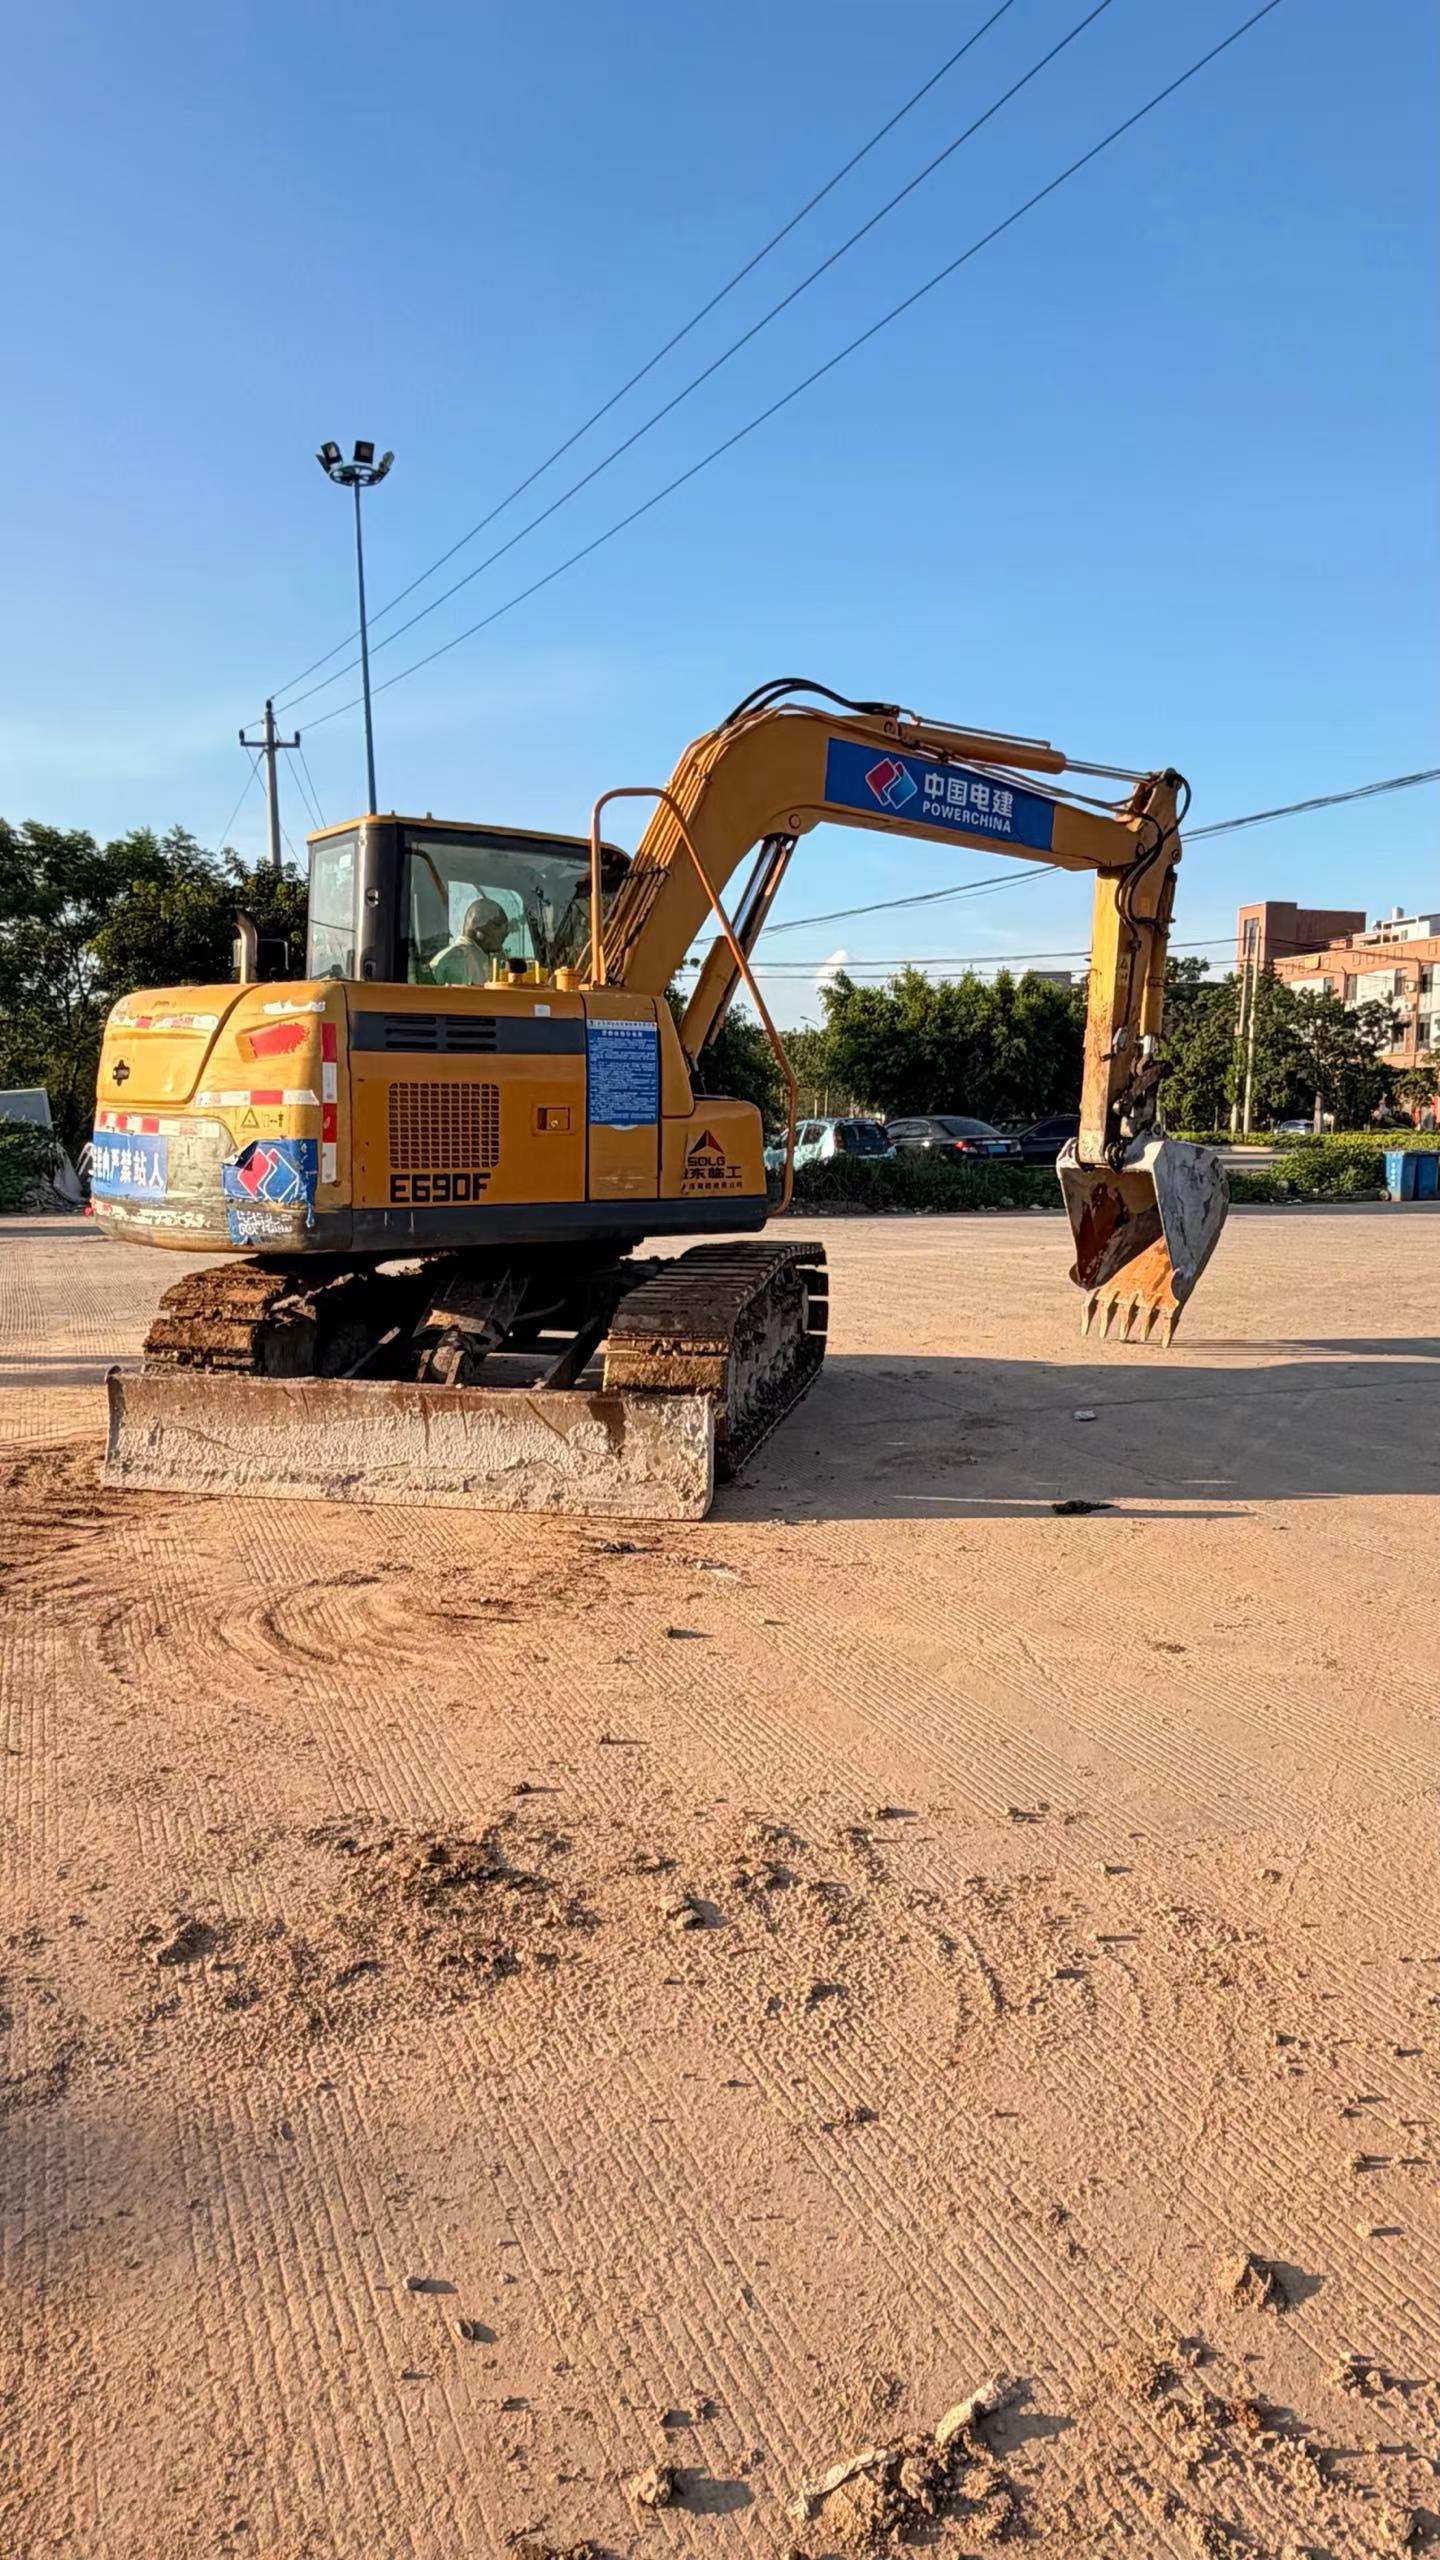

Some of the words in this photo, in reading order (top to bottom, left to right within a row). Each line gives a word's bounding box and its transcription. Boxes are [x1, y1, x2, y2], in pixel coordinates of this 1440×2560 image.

[924, 772, 1013, 818] 中国电建
[922, 800, 1012, 832] POWERCHINA
[390, 1173, 491, 1203] E690F
